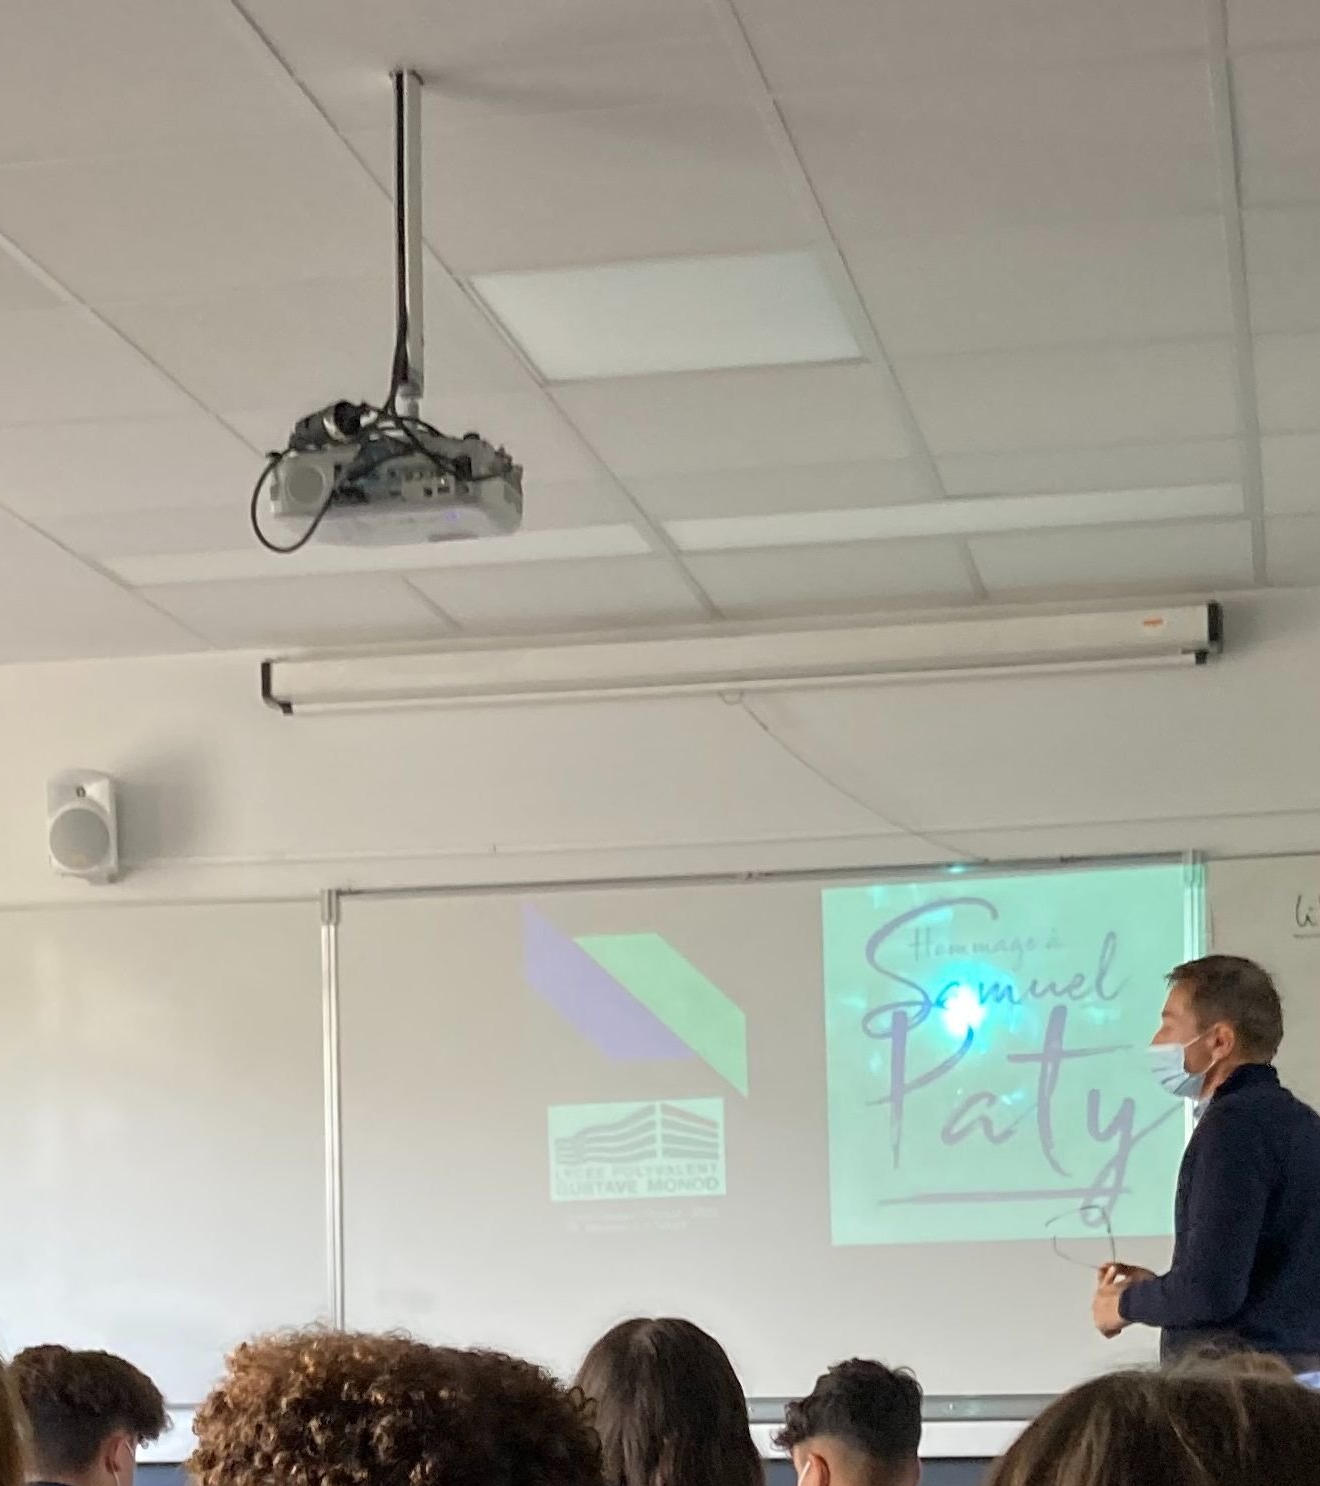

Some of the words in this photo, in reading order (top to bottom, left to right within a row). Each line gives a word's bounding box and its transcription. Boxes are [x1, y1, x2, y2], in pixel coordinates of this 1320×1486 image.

[908, 925, 1038, 969] Hommage
[865, 1004, 1185, 1228] Paty
[646, 1176, 720, 1193] MONOD
